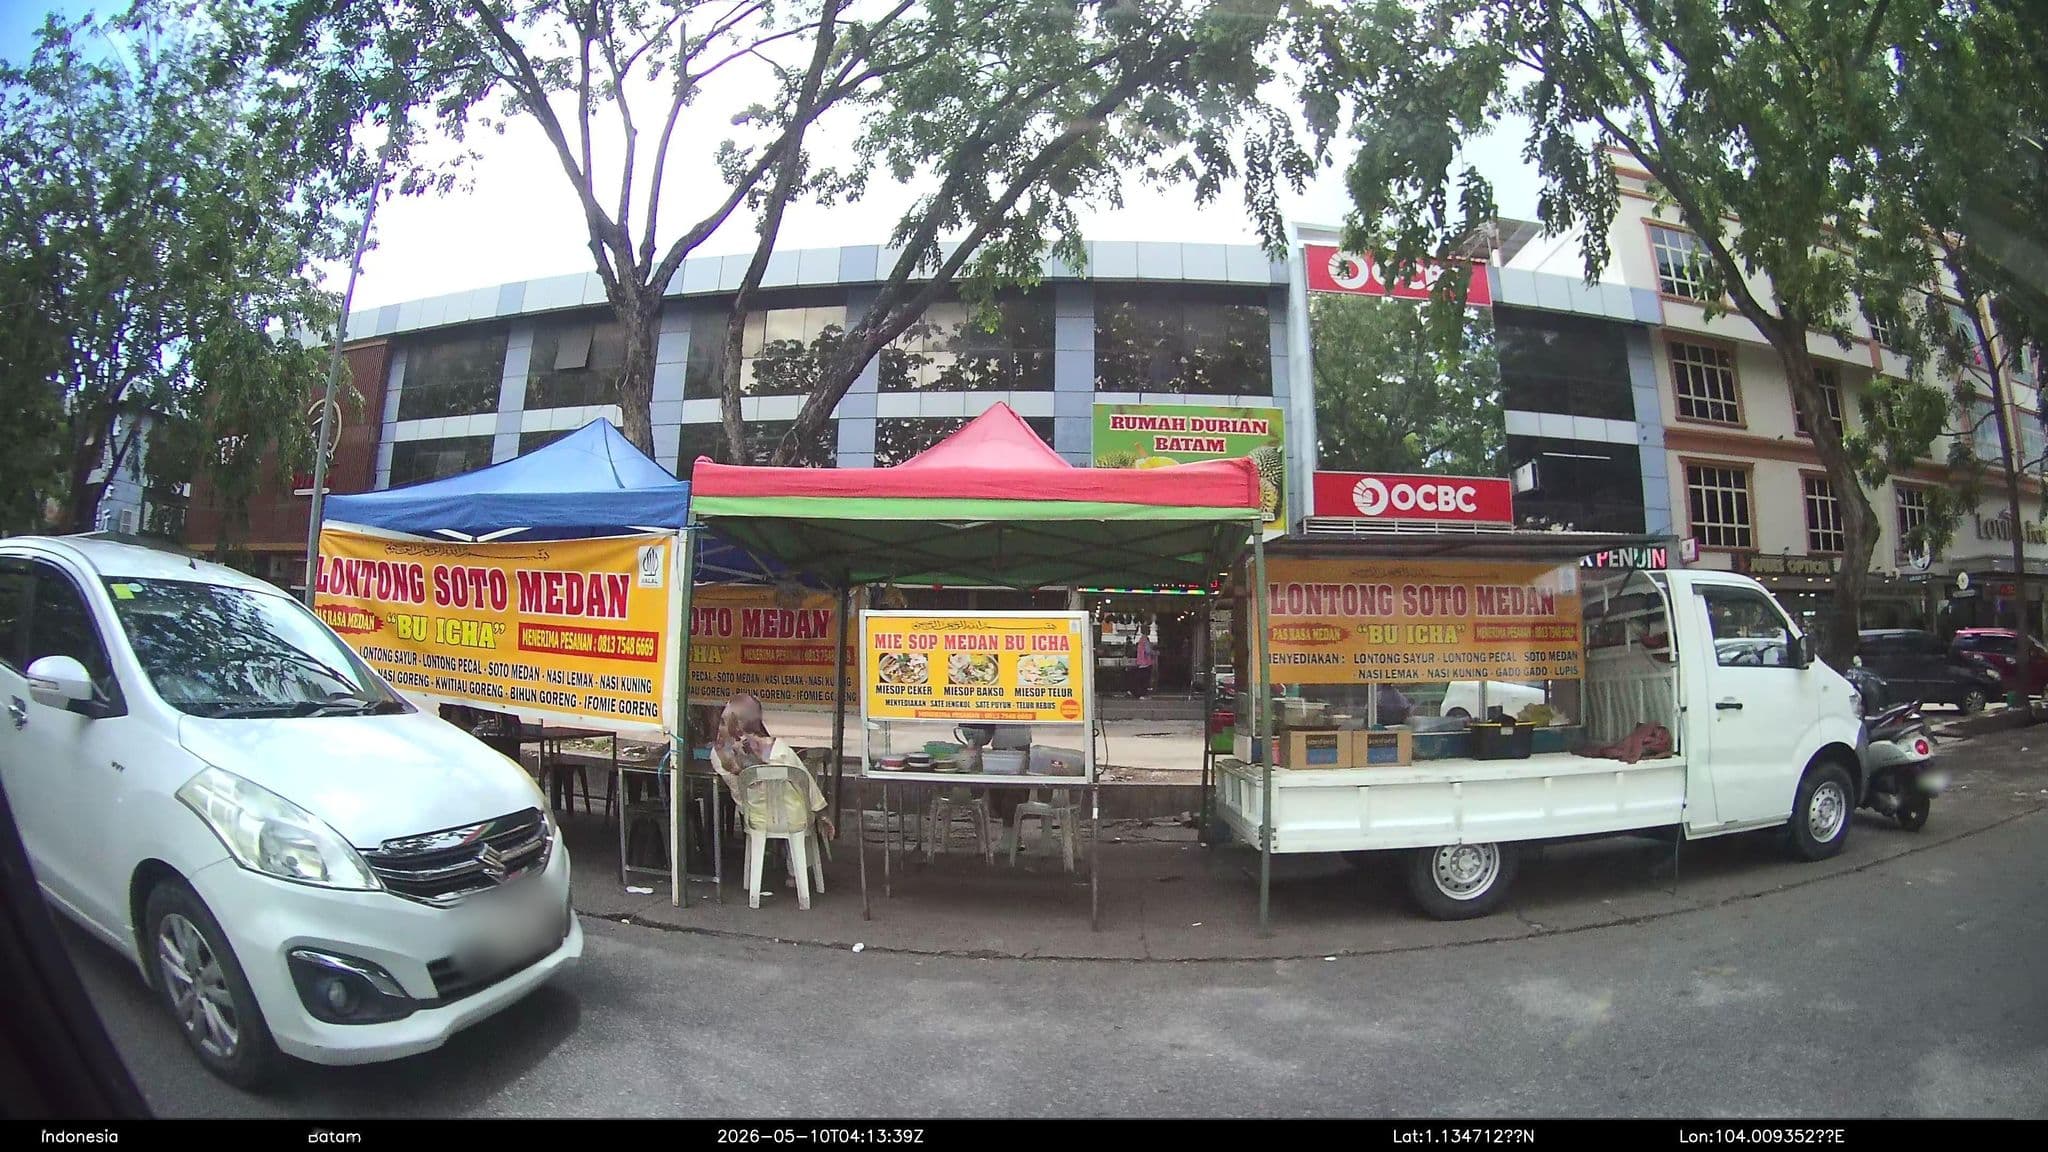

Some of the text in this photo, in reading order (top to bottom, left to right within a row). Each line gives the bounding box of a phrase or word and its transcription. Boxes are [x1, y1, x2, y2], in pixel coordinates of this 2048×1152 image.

[1110, 414, 1268, 435] RUMAH DURIAN
[1155, 436, 1226, 453] BATAM
[1391, 484, 1477, 513] OCBC
[315, 555, 631, 619] LONTONG SOTO MEDAN
[1268, 583, 1556, 618] LONTONG SOTO MEDAN
[347, 612, 376, 631] MEDAN
[690, 606, 830, 639] OTO MEDAN
[522, 627, 654, 657] MENERIMA PESANAN 0813 7548 6669
[875, 634, 1070, 651] MIE SOP MEDAN BU ICHA
[1354, 653, 1400, 664] LONTONG
[1403, 653, 1435, 664] SAYUR
[1443, 653, 1487, 664] LONTONG
[1489, 652, 1517, 663] PECAL
[1524, 652, 1546, 663] SOTO
[1550, 651, 1578, 662] MEDAN
[359, 646, 652, 693] LONTONG SAYUR LONTONG PECAL SOTO MEDAN NASI LEMAK NASI KUNING
[692, 671, 712, 682] PECAL
[717, 672, 735, 683] SOTO
[736, 673, 760, 684] MEDAN
[808, 676, 824, 687] NASI
[1359, 665, 1579, 679] NASI LEMAK NASI KUNING GADO GADO LUPIS
[377, 668, 658, 717] NASI GORENG KWITIAU GORENG BIHUN GORENG IFOMIE GORENG
[701, 687, 731, 697] GORENG
[760, 689, 791, 700] GORENG
[797, 690, 823, 701] IFOMIE
[875, 685, 1073, 697] MIESOP CEKER MIESOP BAKSO MIESOP TELUR
